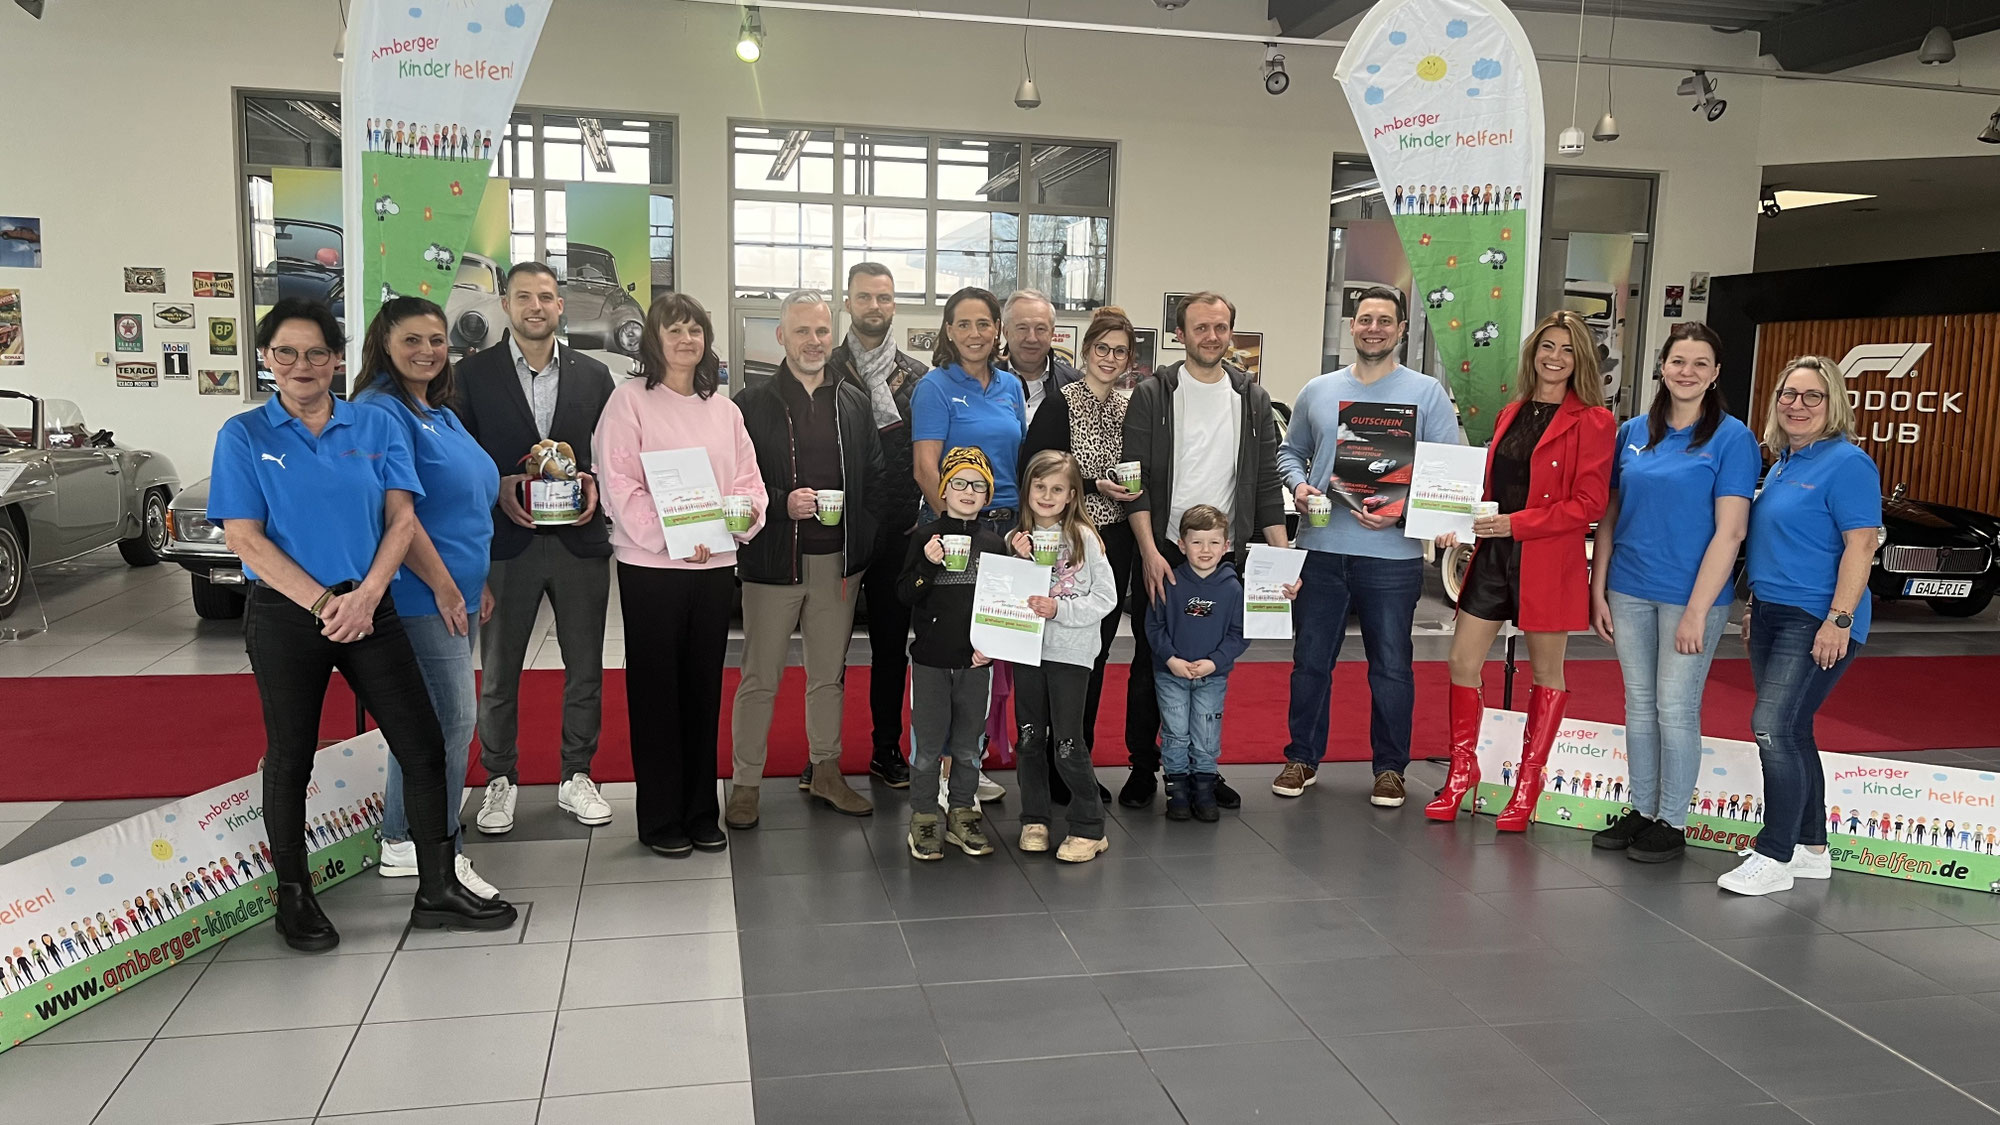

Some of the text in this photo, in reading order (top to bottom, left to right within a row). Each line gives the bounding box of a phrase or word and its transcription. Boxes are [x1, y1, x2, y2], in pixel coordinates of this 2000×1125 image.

[371, 36, 440, 62] Amberger
[399, 58, 514, 81] Kinder helfen!
[1373, 113, 1440, 139] Amberger
[1399, 129, 1513, 150] Kinder helfen!
[136, 275, 153, 285] 66
[193, 278, 234, 290] CHAMPION
[215, 324, 231, 336] BP
[163, 343, 188, 352] Mobil
[118, 367, 155, 375] TEXACO
[170, 353, 180, 374] 1
[1846, 390, 1963, 413] DDOCK
[1350, 416, 1403, 427] GUTSCHEIN
[1915, 582, 1967, 595] GALERIE
[1557, 742, 1608, 757] Kinder
[1834, 766, 1910, 780] Amberger
[1863, 781, 1995, 807] Kinder helfen!
[198, 789, 250, 831] Amberger
[224, 805, 263, 832] Kinde
[0, 888, 55, 925] elfen!
